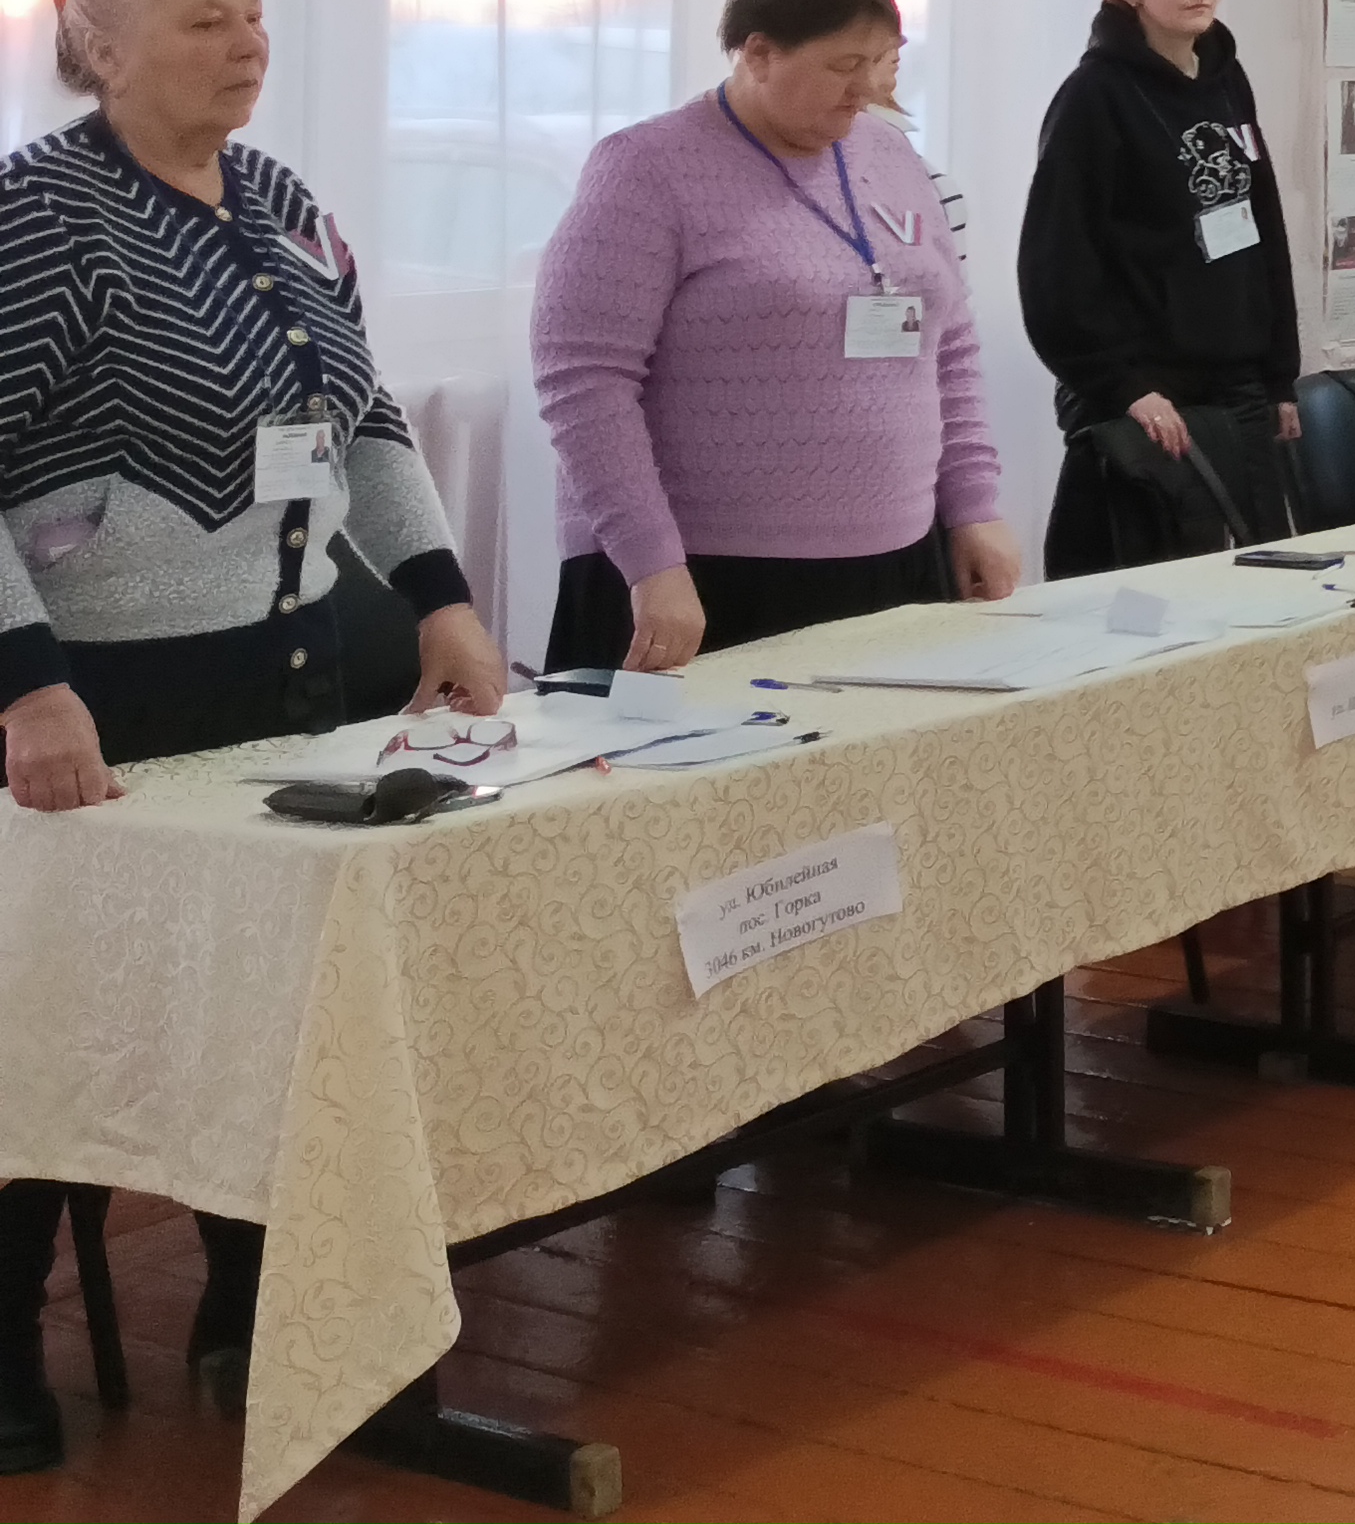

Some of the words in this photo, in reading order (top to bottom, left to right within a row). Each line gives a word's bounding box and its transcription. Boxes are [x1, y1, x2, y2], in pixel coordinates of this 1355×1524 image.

[744, 856, 840, 905] Юбилейная
[774, 890, 822, 919] Горка
[769, 900, 866, 948] Новогутово
